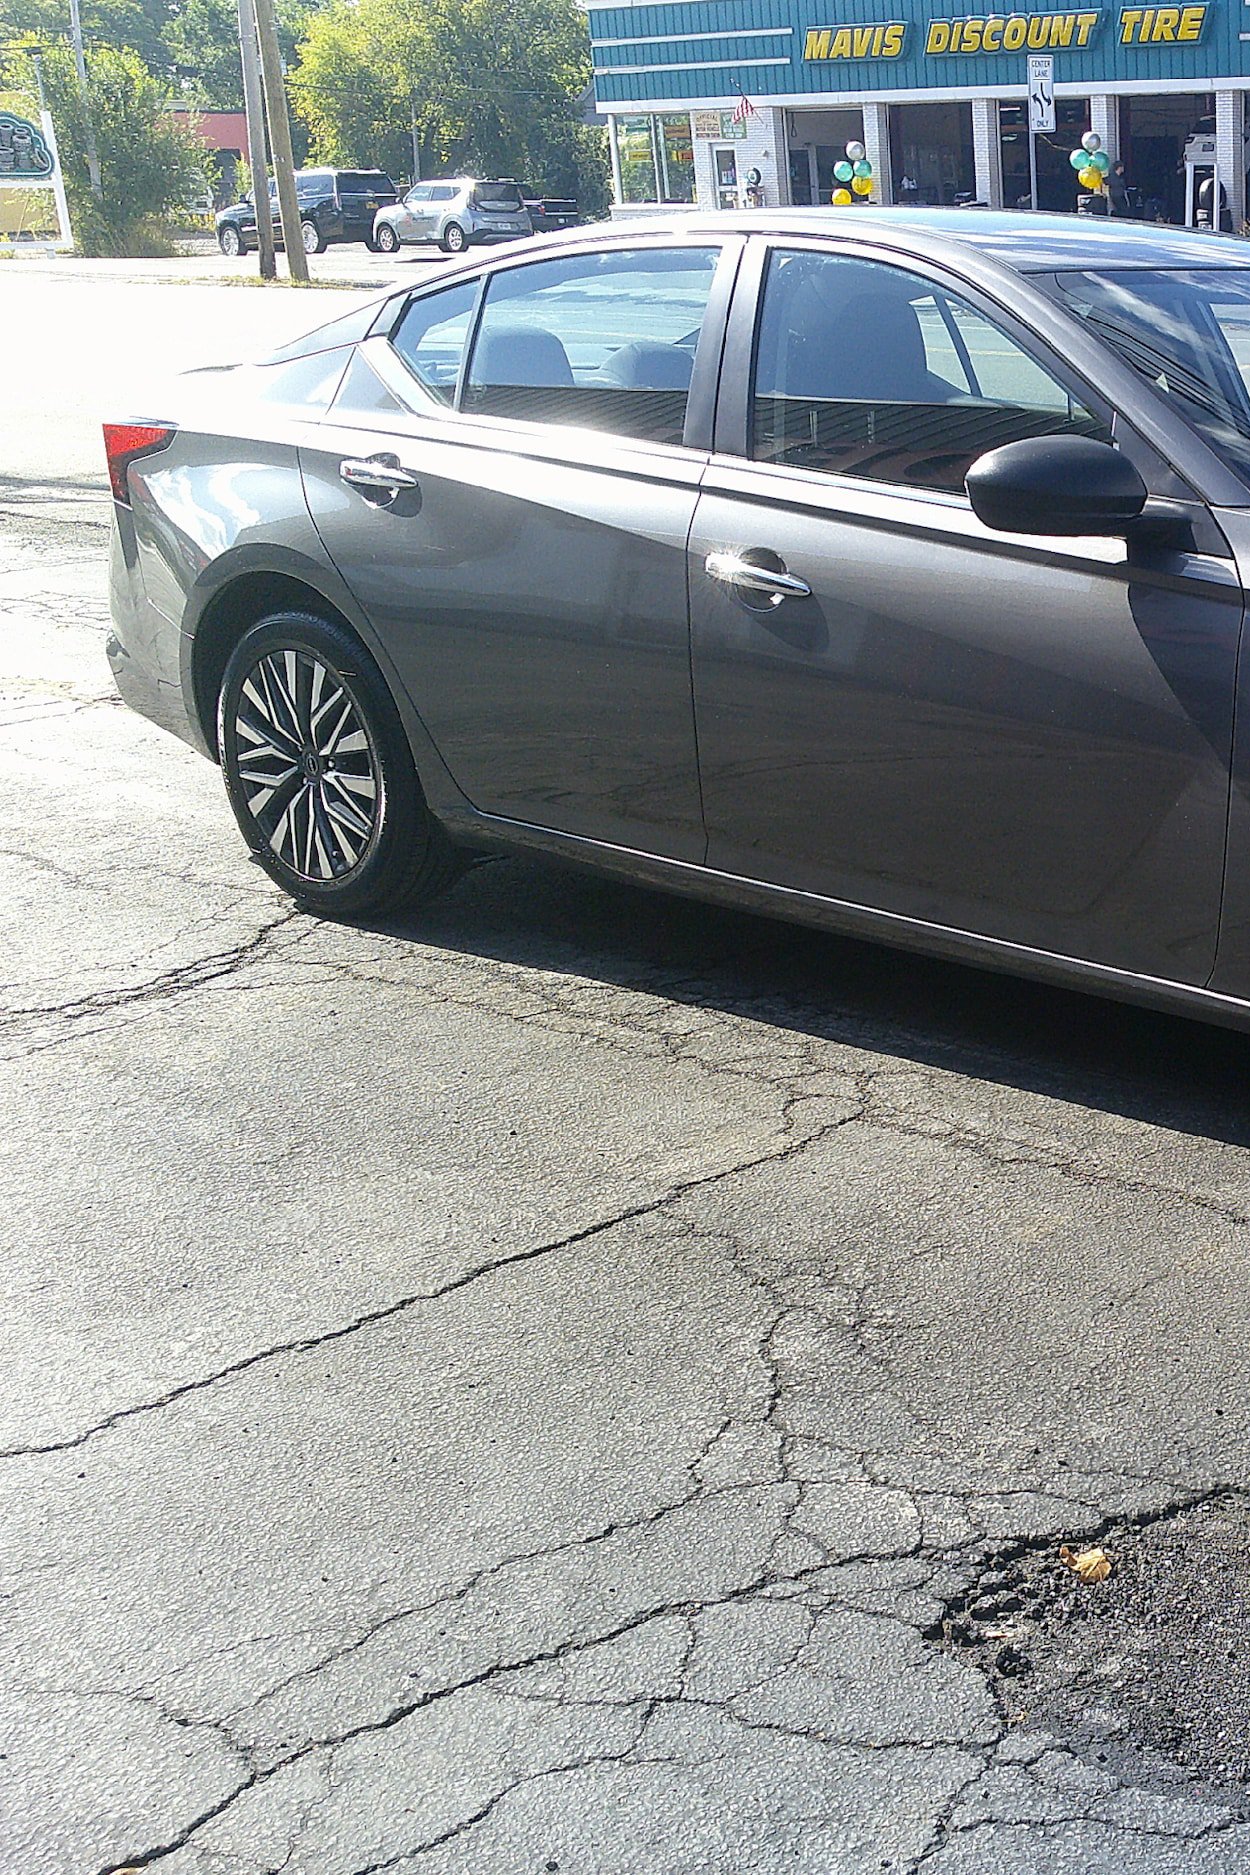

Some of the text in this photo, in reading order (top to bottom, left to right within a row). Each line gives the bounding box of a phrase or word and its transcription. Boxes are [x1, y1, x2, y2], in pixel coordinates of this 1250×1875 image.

[804, 7, 1206, 61] MAVIS DISCOUNT TIRE
